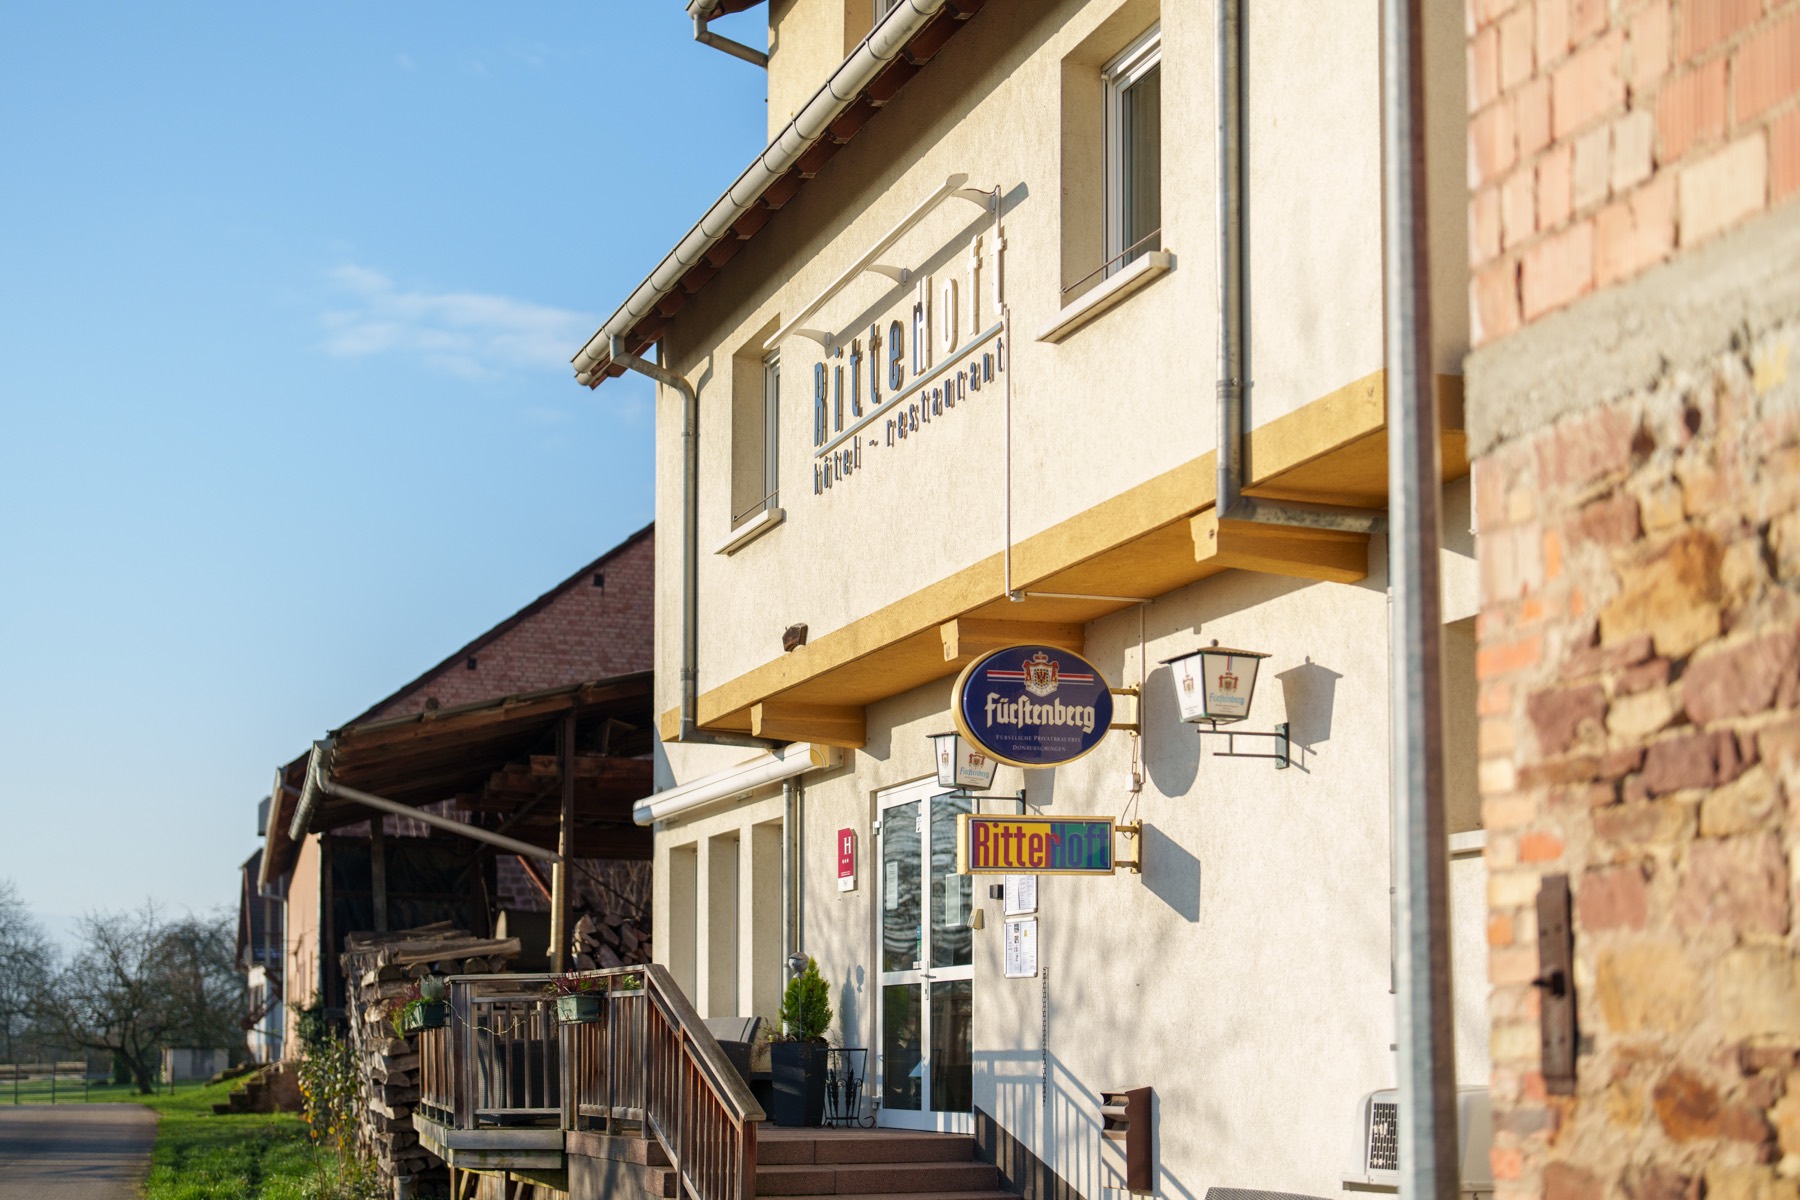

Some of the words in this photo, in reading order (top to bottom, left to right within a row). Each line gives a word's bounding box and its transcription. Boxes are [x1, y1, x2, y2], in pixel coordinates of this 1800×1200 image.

[886, 337, 1003, 447] restaurant
[984, 691, 1095, 734] Fürstenberg
[843, 836, 852, 855] H
